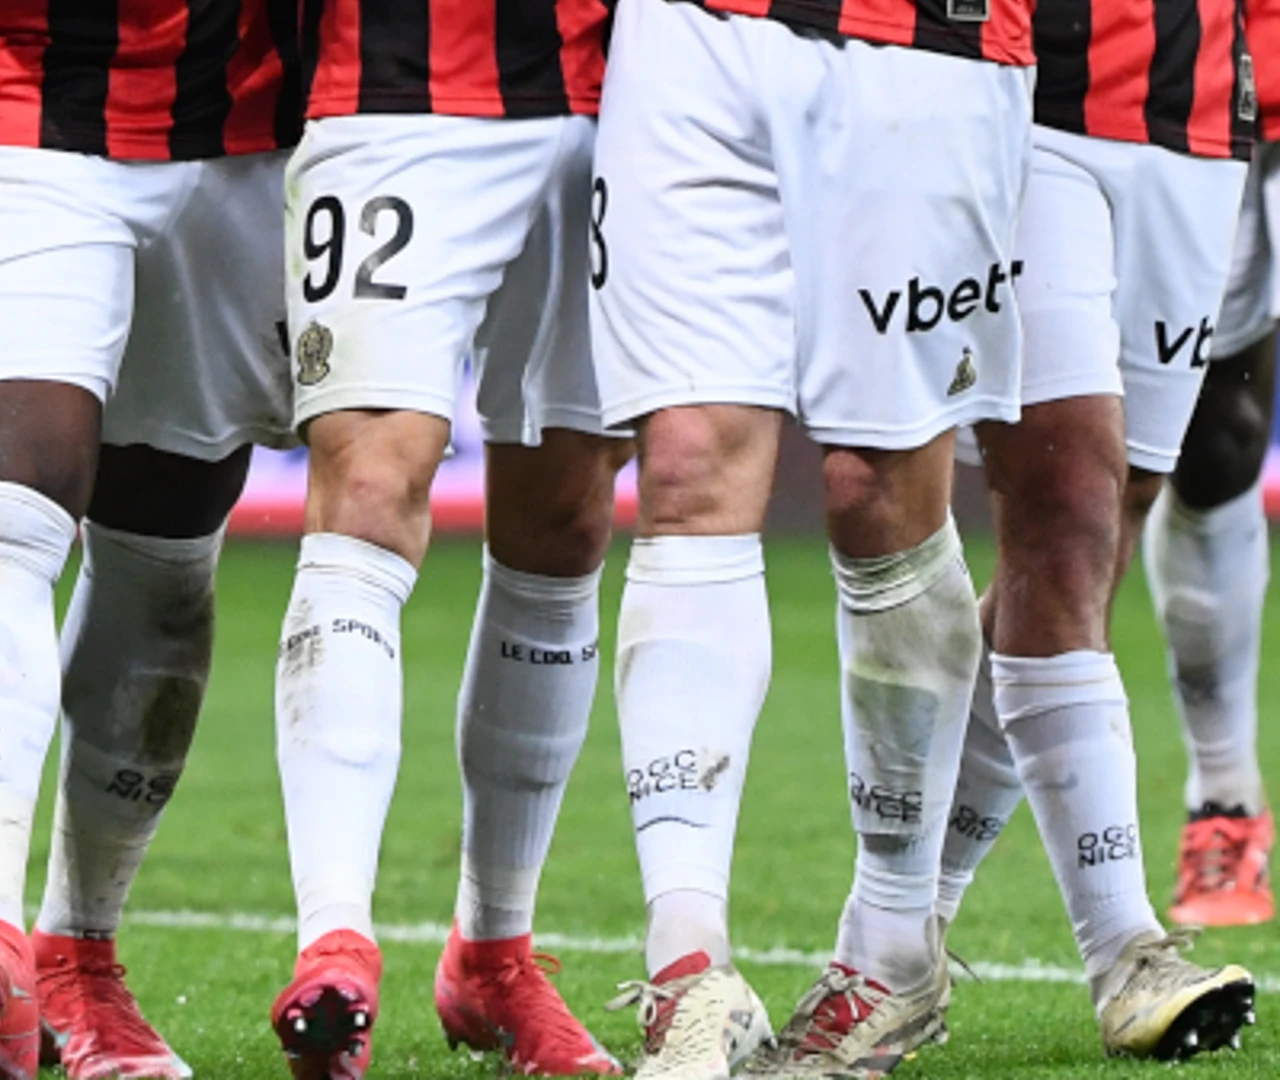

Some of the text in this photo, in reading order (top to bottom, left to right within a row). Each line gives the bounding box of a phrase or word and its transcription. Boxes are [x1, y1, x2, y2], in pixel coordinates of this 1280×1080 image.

[303, 195, 414, 303] 92
[857, 259, 1024, 335] vbet
[501, 641, 523, 661] LE
[627, 749, 698, 785] OGC
[629, 772, 698, 806] NICE
